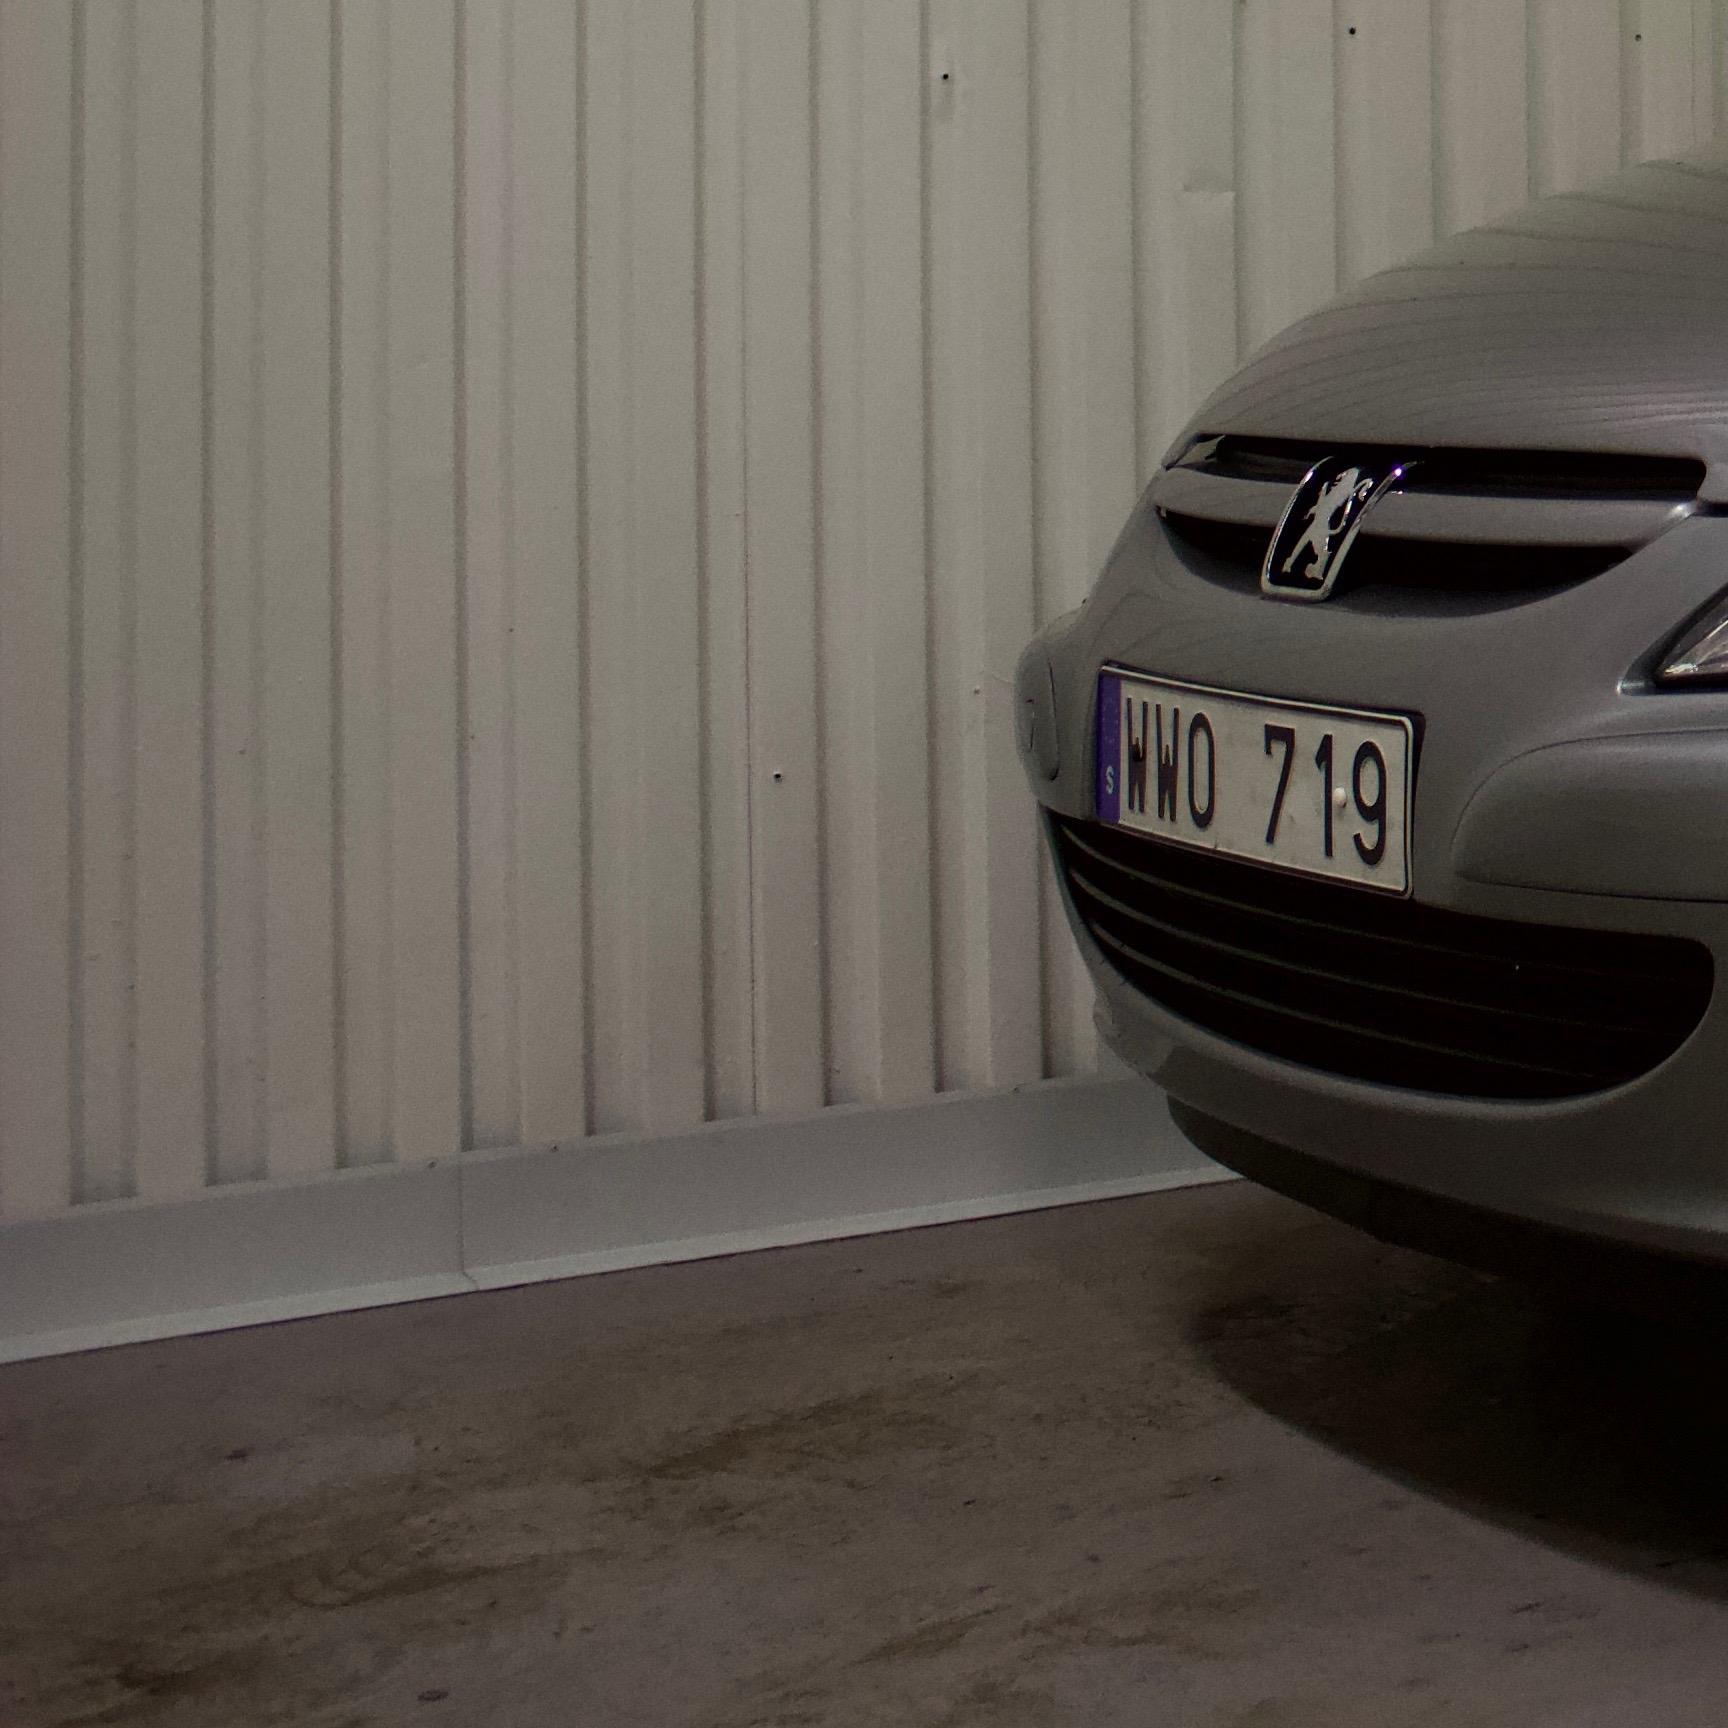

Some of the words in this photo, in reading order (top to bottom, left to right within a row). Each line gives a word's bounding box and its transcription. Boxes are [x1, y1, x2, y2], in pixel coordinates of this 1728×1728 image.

[1104, 765, 1115, 795] S
[1126, 697, 1215, 829] WWO
[1264, 723, 1387, 865] 719
